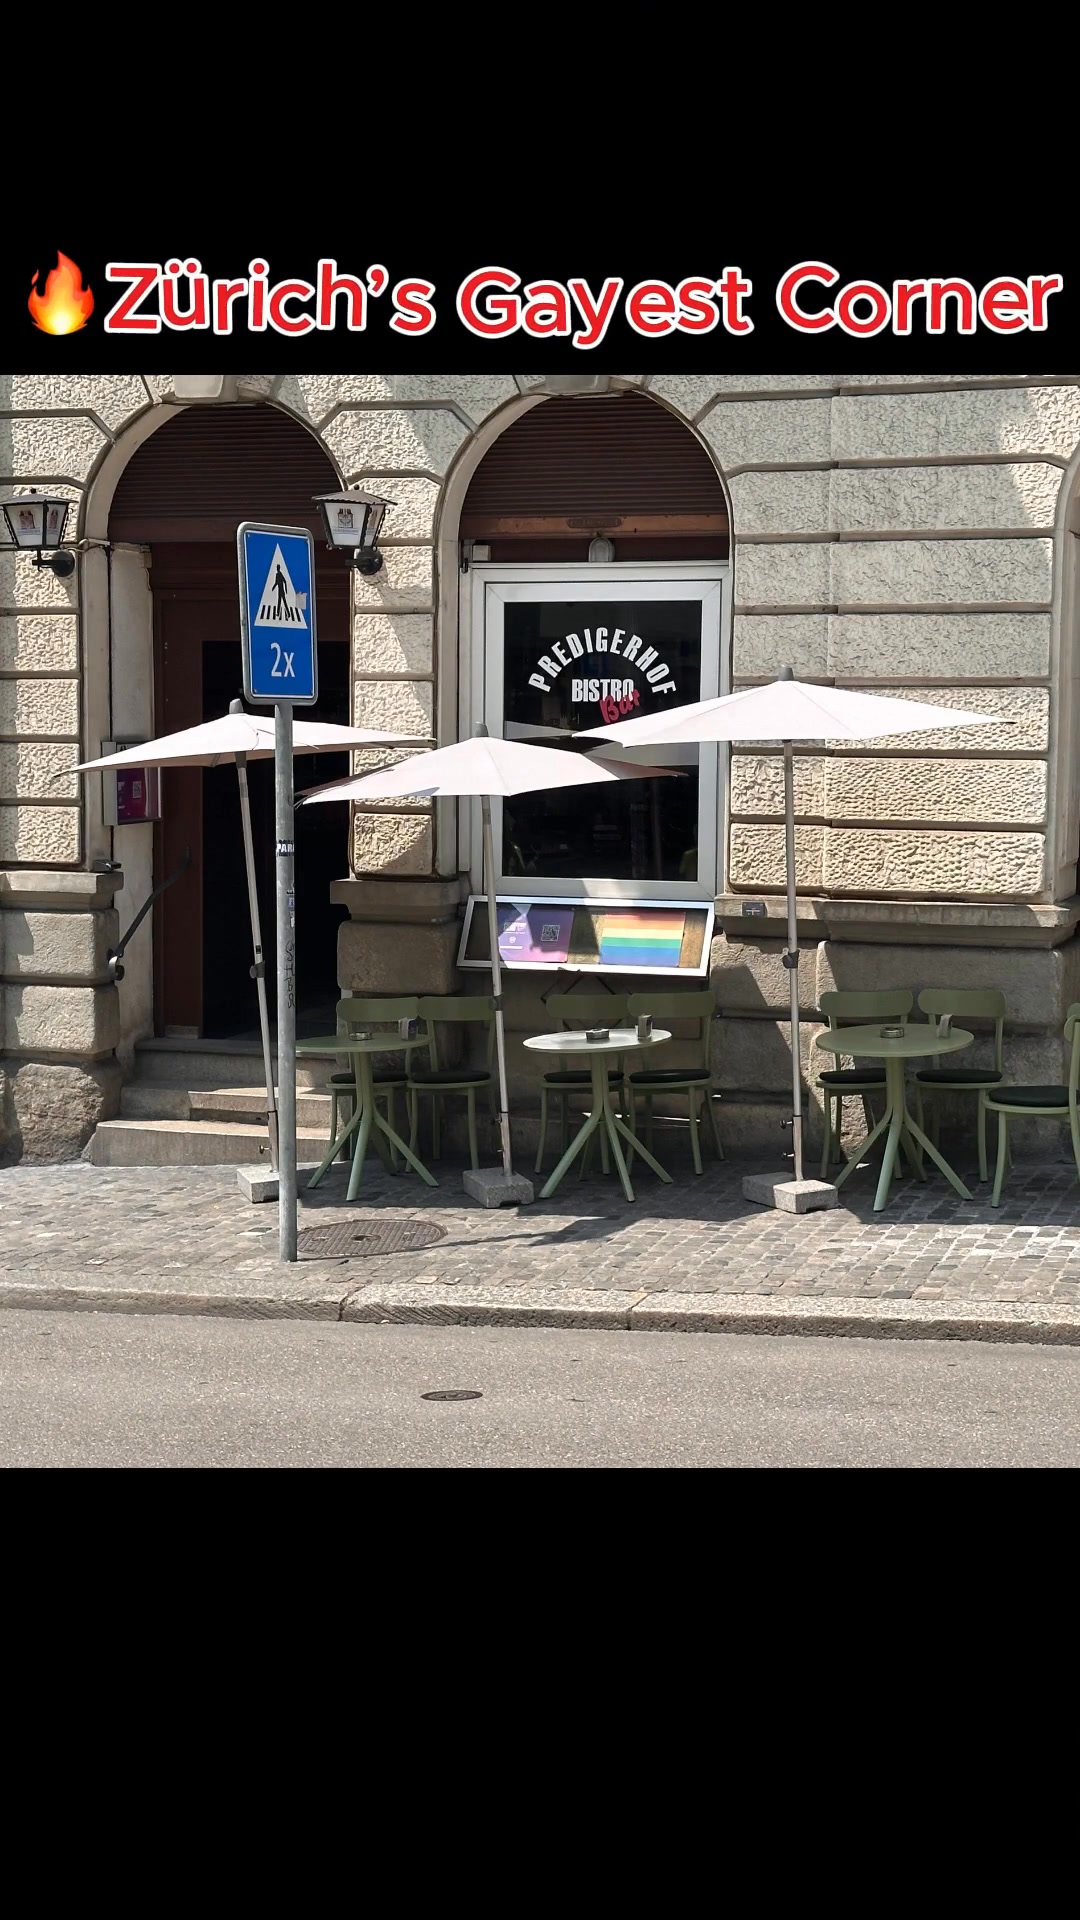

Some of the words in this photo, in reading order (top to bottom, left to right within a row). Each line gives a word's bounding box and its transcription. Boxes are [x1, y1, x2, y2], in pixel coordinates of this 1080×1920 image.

[270, 642, 295, 678] 2x
[528, 627, 677, 695] PREDIGERHOF
[571, 678, 634, 702] BISTRO
[600, 689, 640, 723] Bar
